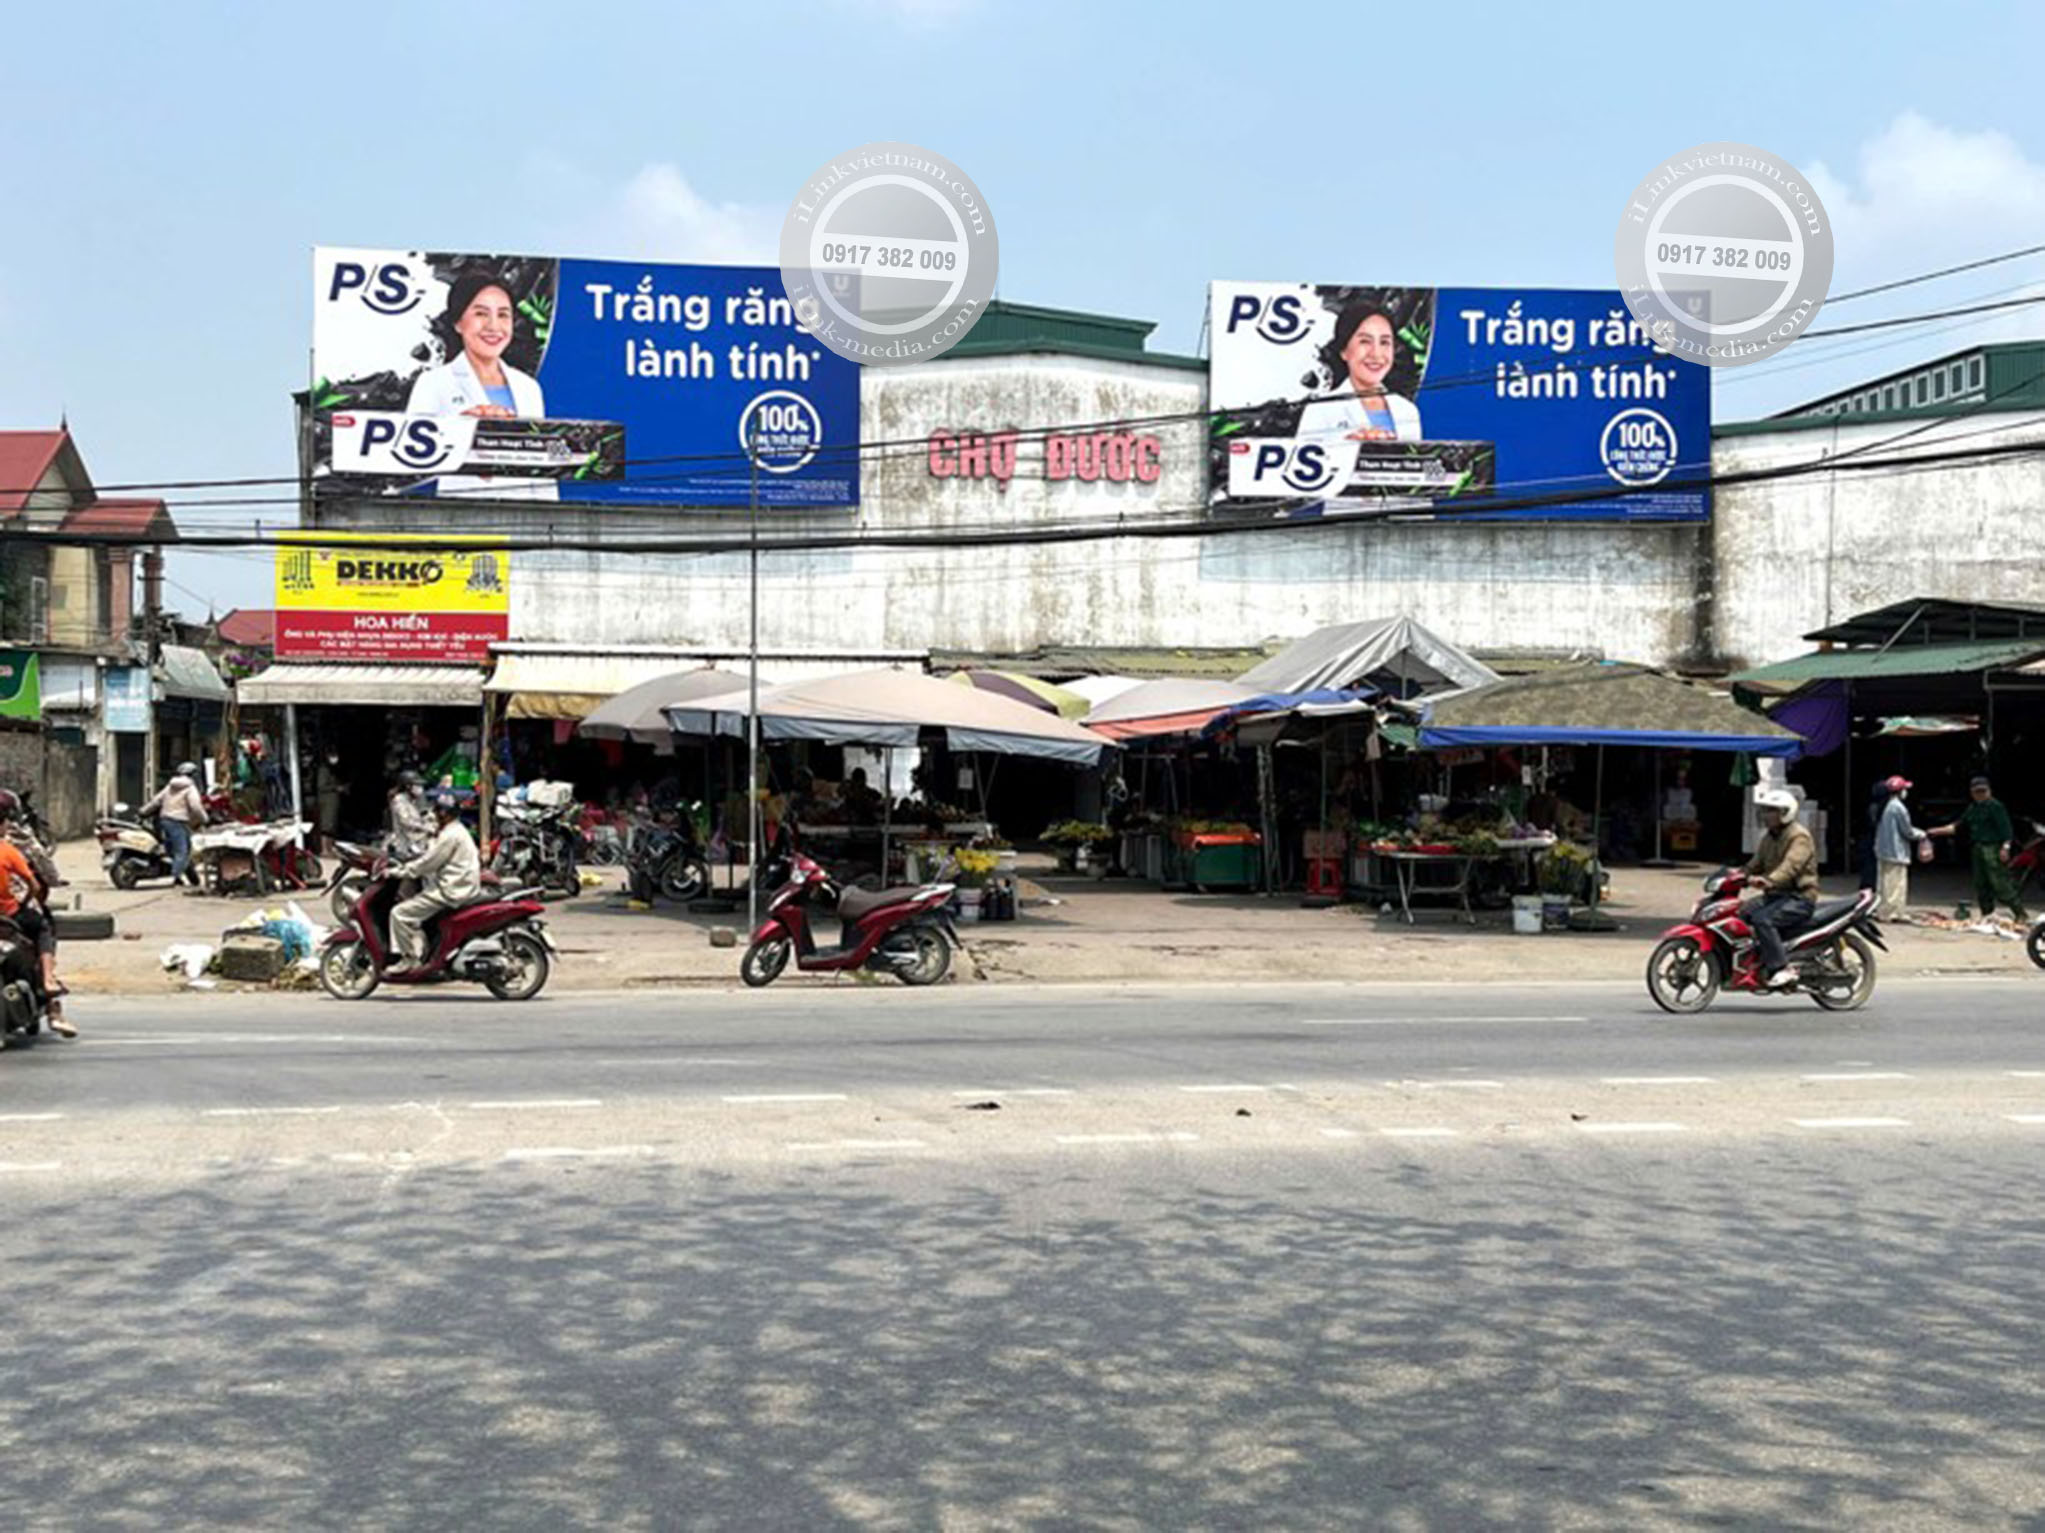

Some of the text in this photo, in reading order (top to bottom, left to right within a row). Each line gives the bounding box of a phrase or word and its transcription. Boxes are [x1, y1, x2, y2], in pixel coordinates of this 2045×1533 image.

[585, 275, 821, 334] Trắng răng
[1460, 300, 1675, 354] Trắng răng
[626, 339, 714, 379] lành
[1496, 361, 1578, 398] lành
[336, 560, 443, 585] DEKKO
[353, 615, 389, 629] HOA
